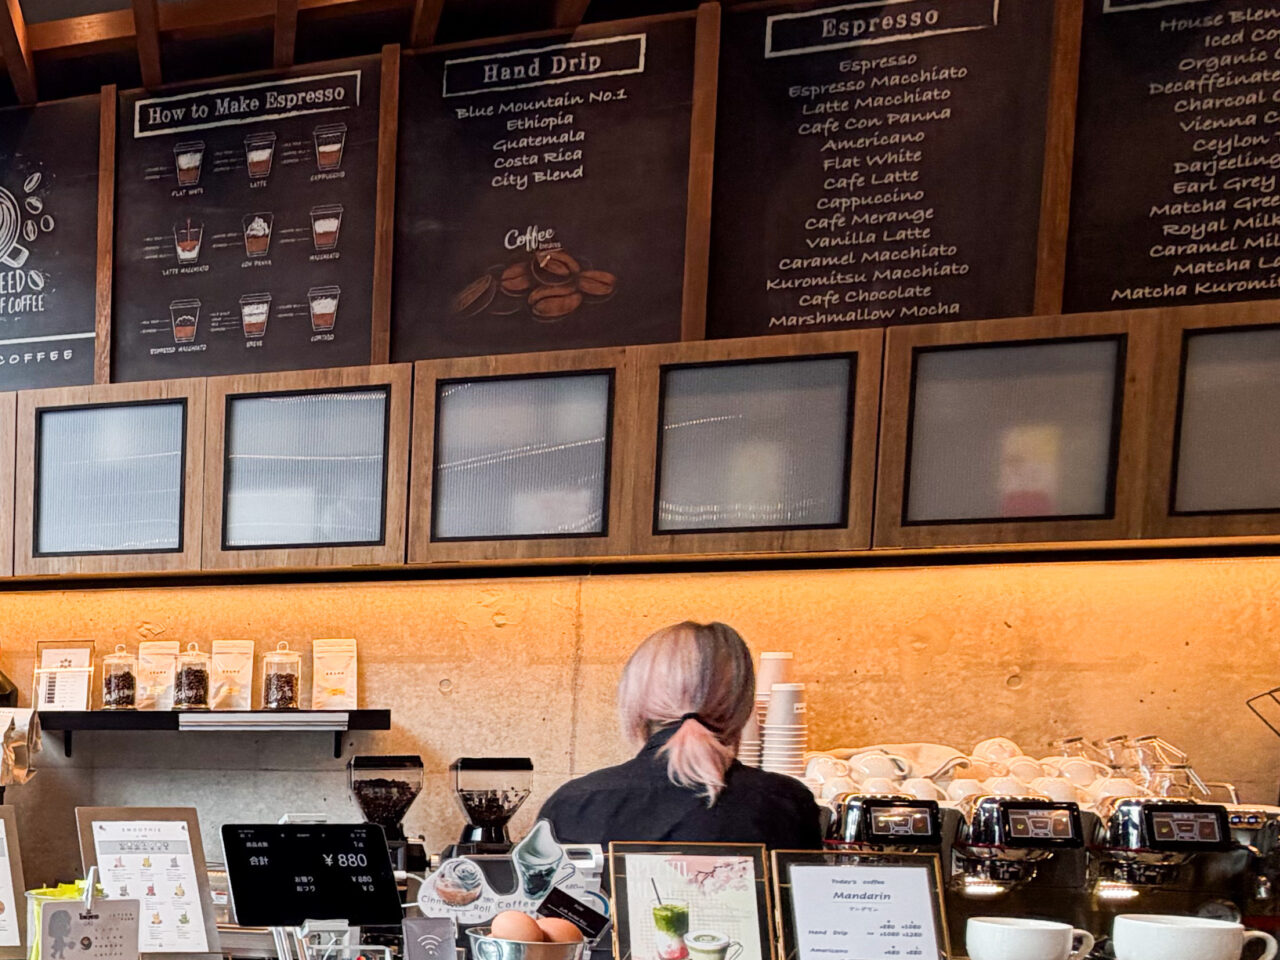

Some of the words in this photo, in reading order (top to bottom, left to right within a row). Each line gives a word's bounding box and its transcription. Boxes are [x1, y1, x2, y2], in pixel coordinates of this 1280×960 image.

[821, 9, 939, 38] Espresso
[1160, 14, 1224, 32] House
[1204, 29, 1245, 47] Iced
[482, 57, 541, 83] Hand
[550, 52, 602, 74] Drip
[840, 54, 917, 74] Espresso
[1178, 48, 1269, 72] Organic
[789, 79, 866, 99] Espresso
[870, 66, 968, 89] Macchiato
[147, 106, 186, 125] How
[191, 103, 209, 119] to
[214, 95, 260, 116] Make
[265, 86, 345, 109] Espresso
[455, 105, 495, 119] Blue
[498, 92, 584, 114] Mountain
[588, 88, 628, 103] No.1
[802, 99, 850, 116] Latte
[854, 88, 951, 110] Macchiato
[1173, 89, 1267, 113] Charcoal
[506, 111, 574, 131] Ethiopia
[798, 118, 840, 136] Cafe
[844, 116, 883, 129] Con
[887, 107, 952, 126] Panna
[1179, 114, 1257, 132] Vienna
[492, 130, 586, 152] Guatemala
[820, 131, 926, 152] Americano
[1192, 134, 1270, 155] Ceylon
[493, 153, 539, 169] Costa
[543, 148, 583, 163] Rica
[823, 156, 861, 172] Flat
[865, 150, 923, 167] White
[1174, 151, 1280, 177] Darjeeling
[491, 172, 529, 190] City
[532, 165, 584, 183] Blend
[823, 174, 866, 191] Cafe
[871, 169, 920, 186] Latte
[1173, 178, 1217, 195] Earl
[1222, 175, 1276, 193] Grey
[816, 188, 925, 213] Cappuccino
[1149, 199, 1227, 218] Matcha
[805, 213, 847, 231] Cafe
[851, 207, 935, 226] Merange
[1162, 218, 1229, 240] Royal
[504, 224, 555, 252] Coffee
[806, 231, 877, 249] Vanilla
[882, 226, 932, 242] Latte
[1149, 237, 1238, 258] Caramel
[778, 253, 856, 271] Caramel
[861, 243, 957, 264] Macchiato
[1173, 259, 1252, 276] Matcha
[766, 271, 867, 291] Kuromitsu
[872, 261, 970, 282] Macchiato
[799, 291, 840, 309] Cafe
[844, 284, 933, 304] Chocolate
[1111, 283, 1188, 302] Matcha
[8, 294, 45, 314] COFFEE
[769, 308, 896, 328] Marshmallow
[899, 301, 961, 318] Mocha
[249, 856, 269, 866] 合計
[833, 891, 891, 901] Mandarin
